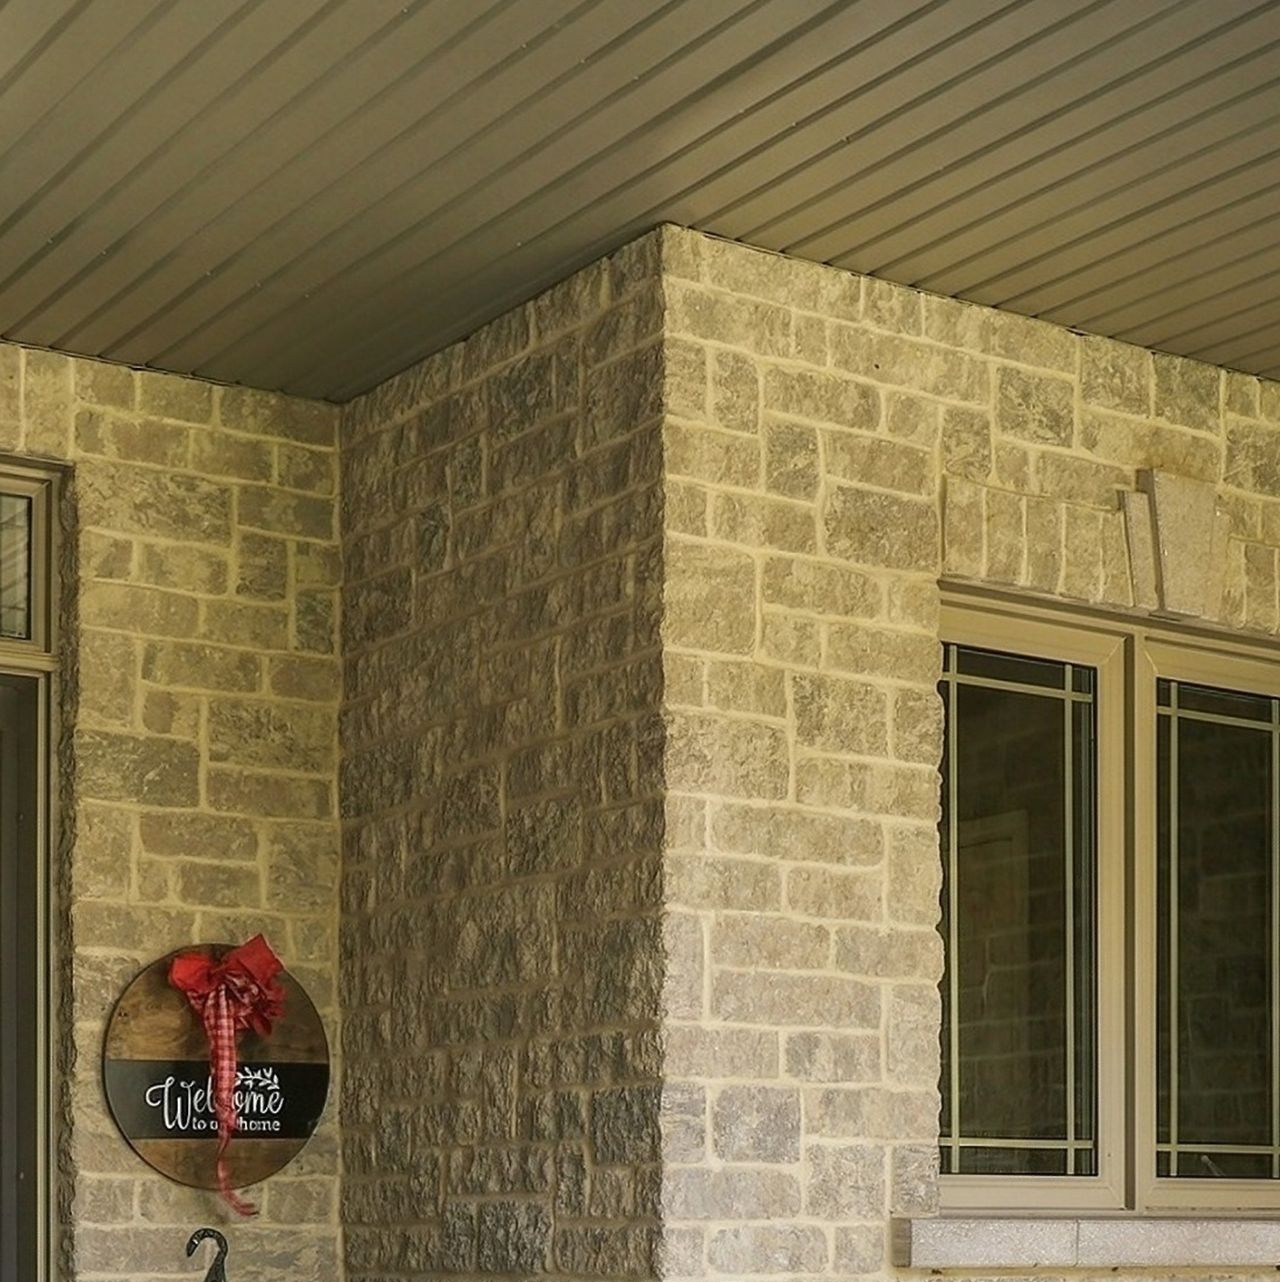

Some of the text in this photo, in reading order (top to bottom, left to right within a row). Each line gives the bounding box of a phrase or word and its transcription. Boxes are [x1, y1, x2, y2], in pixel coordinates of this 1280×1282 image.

[145, 1076, 284, 1129] Welome
[192, 1117, 207, 1131] to
[239, 1116, 281, 1131] home
